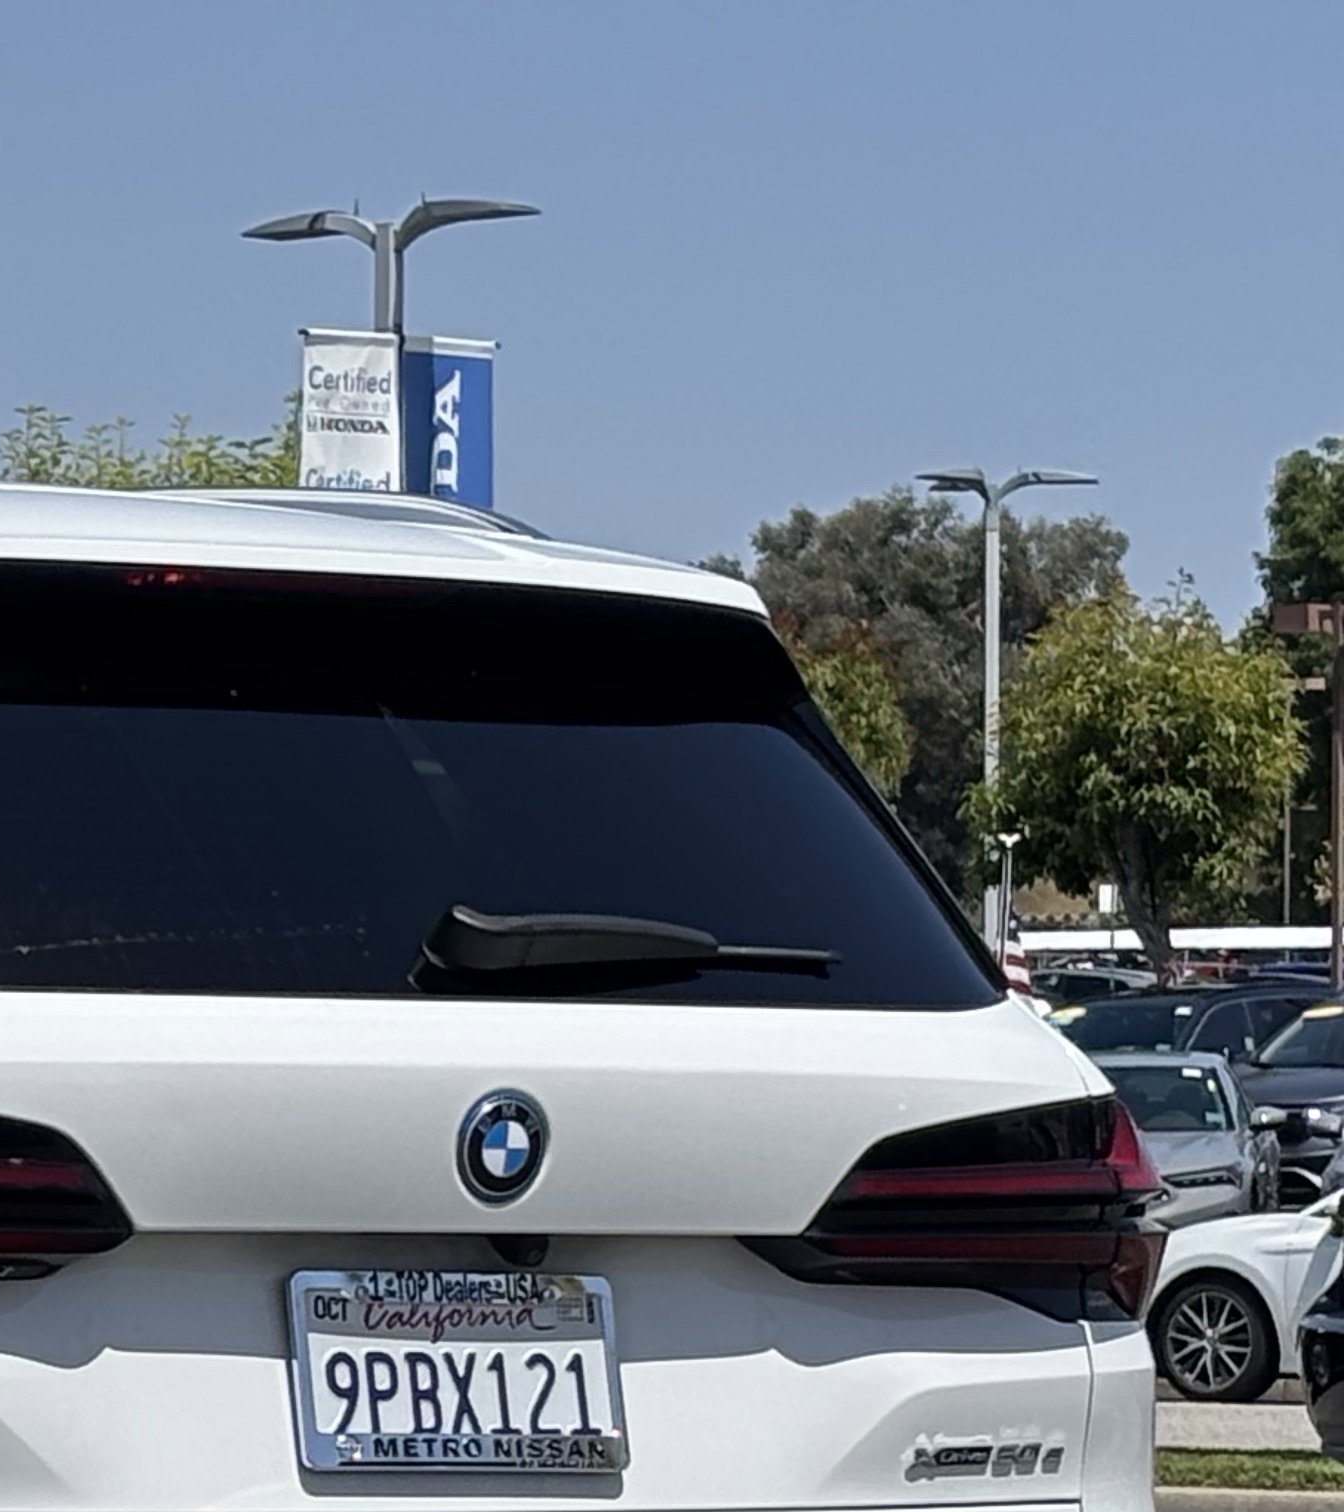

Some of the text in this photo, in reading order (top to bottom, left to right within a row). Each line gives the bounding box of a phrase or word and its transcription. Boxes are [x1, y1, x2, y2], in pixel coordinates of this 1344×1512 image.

[308, 365, 392, 395] Certified
[320, 416, 390, 435] HONDA
[313, 1295, 350, 1322] OCT
[364, 1300, 556, 1342] California
[325, 1350, 603, 1437] 9PBX121
[373, 1437, 483, 1459] METRO
[494, 1437, 608, 1460] NISSAN
